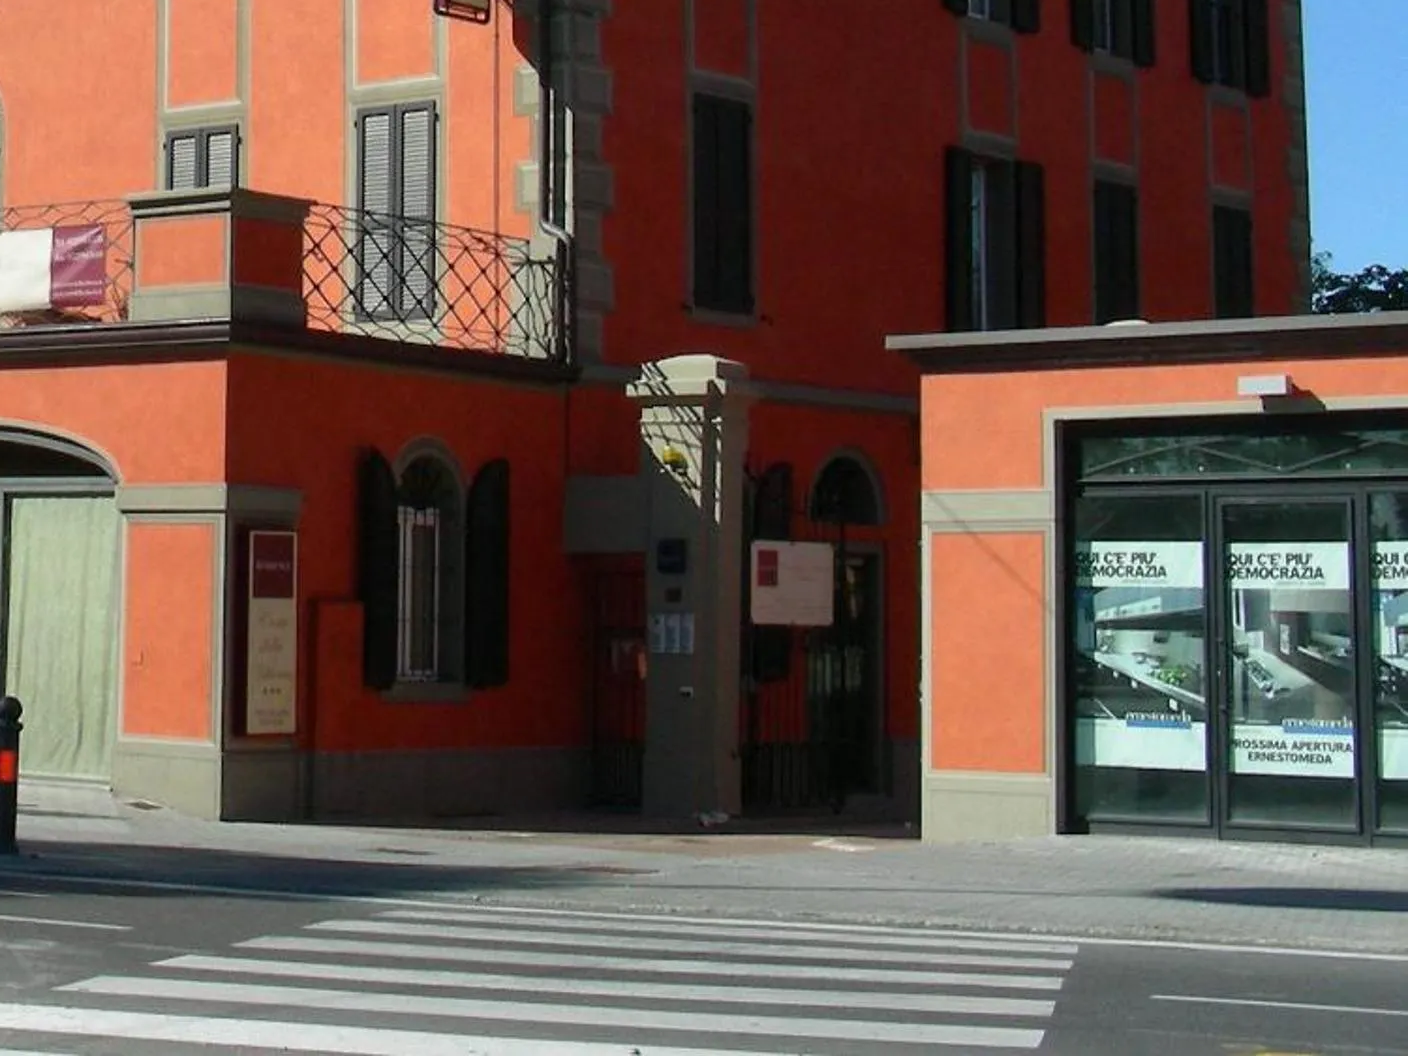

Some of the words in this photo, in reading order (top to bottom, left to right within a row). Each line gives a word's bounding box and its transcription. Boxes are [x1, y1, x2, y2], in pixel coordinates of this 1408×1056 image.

[1227, 552, 1253, 566] QUI
[1372, 552, 1399, 565] QUI
[1227, 566, 1325, 579] DEMOCRAZIA
[1372, 566, 1408, 579] DEM
[1247, 751, 1333, 764] ERNESTOMEDA
